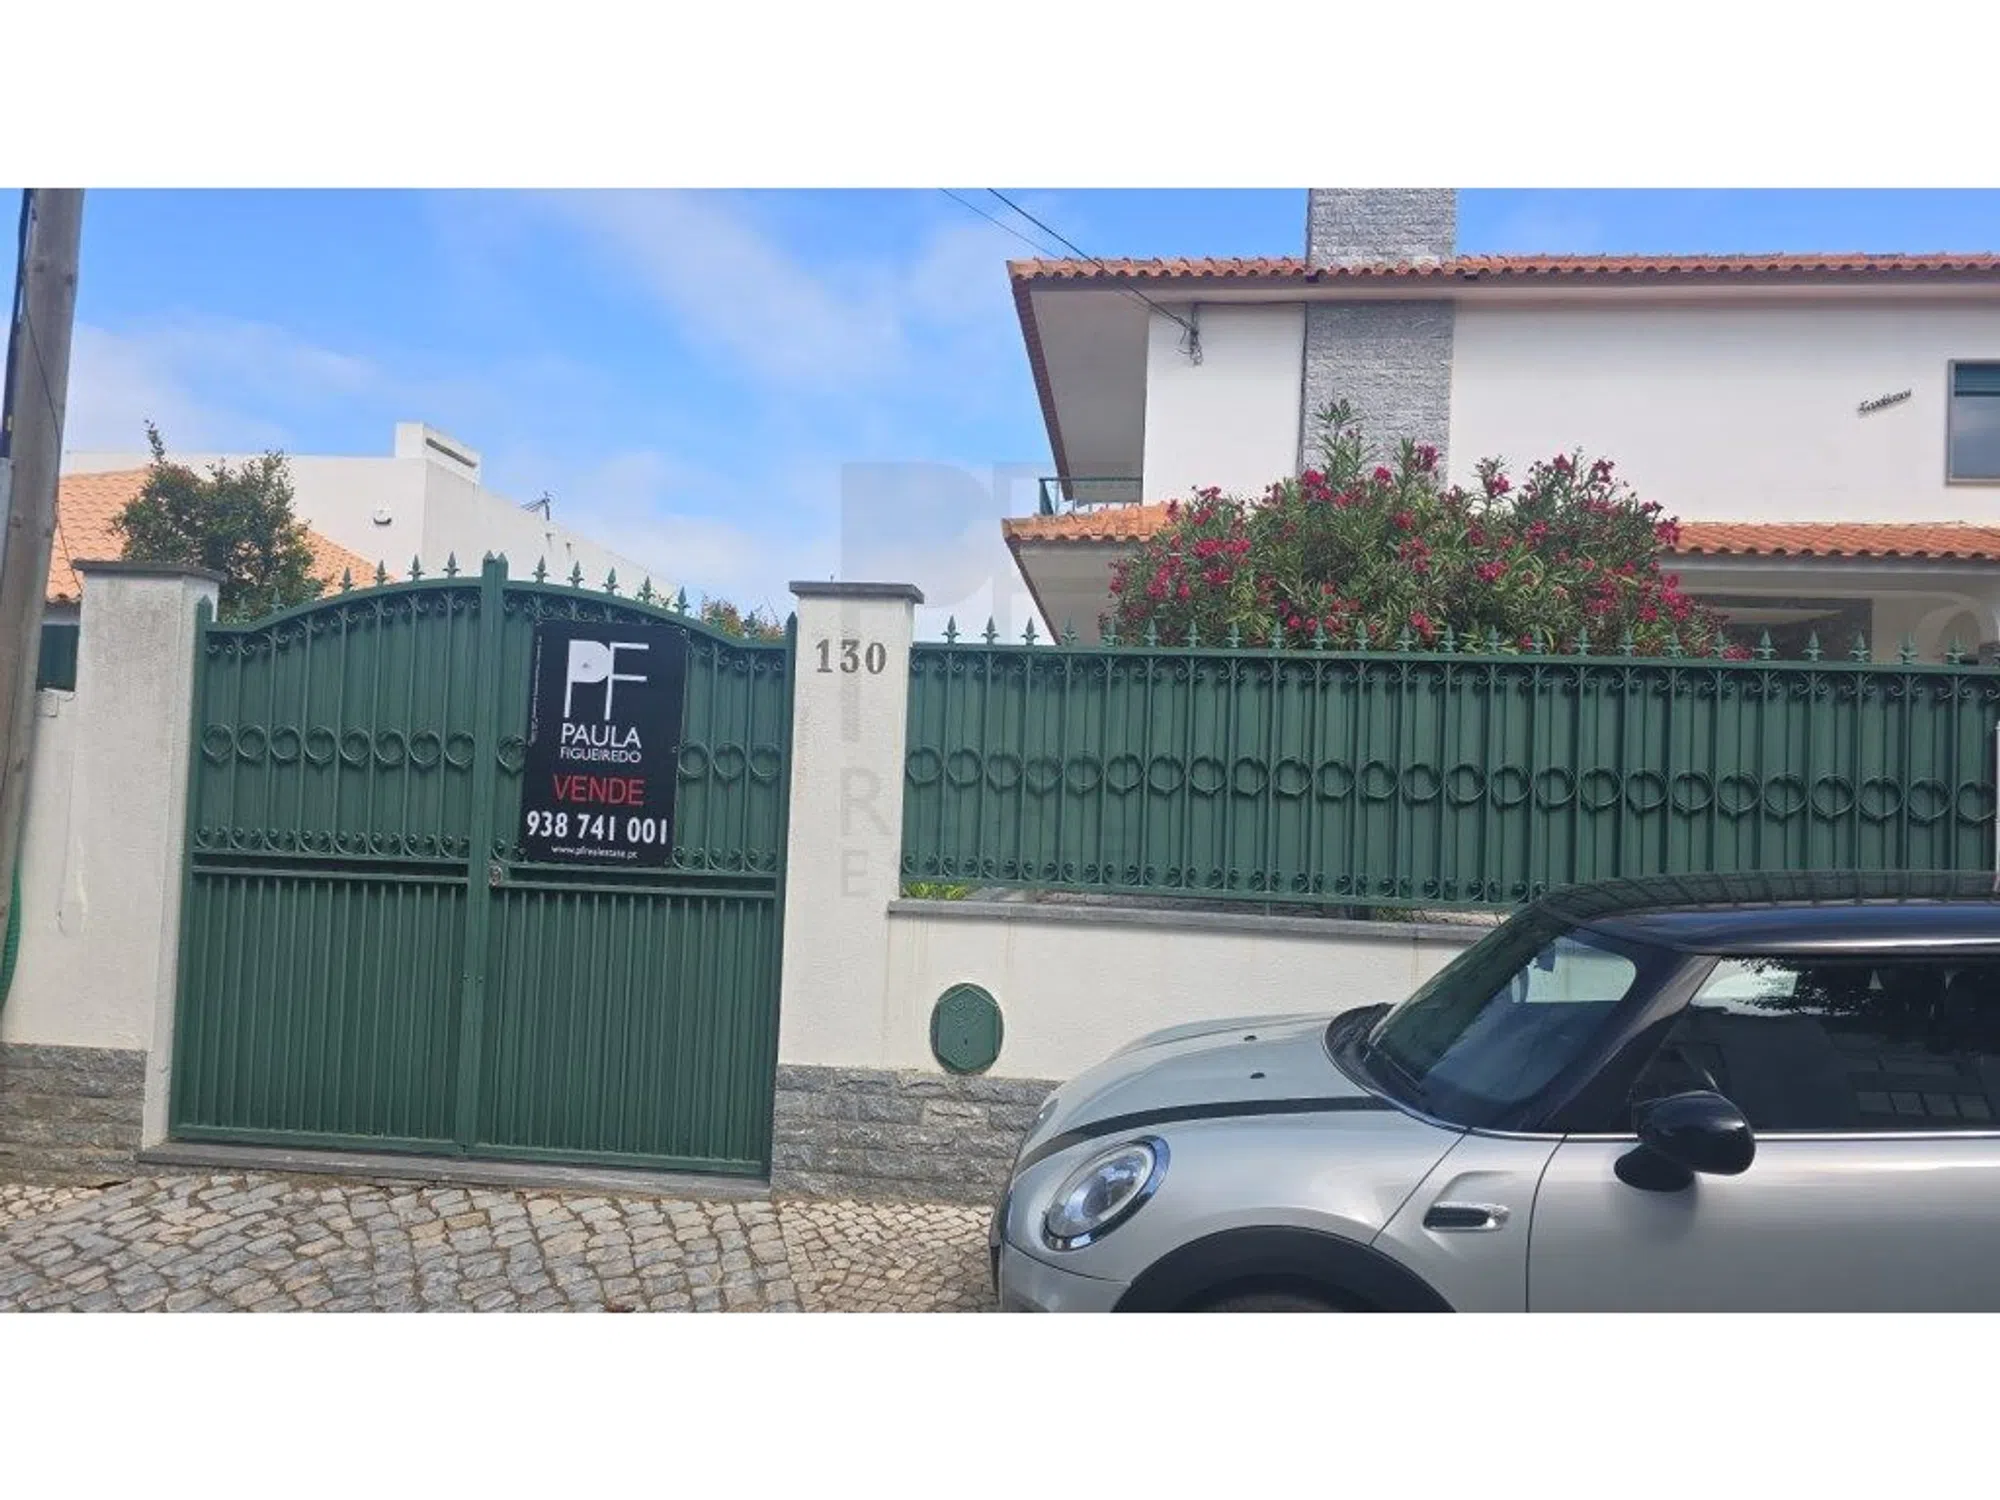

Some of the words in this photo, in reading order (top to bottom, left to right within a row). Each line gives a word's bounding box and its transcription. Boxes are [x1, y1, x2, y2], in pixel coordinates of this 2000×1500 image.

[816, 638, 886, 674] 130
[563, 639, 650, 721] PF
[560, 722, 642, 749] PAULA
[559, 746, 642, 764] FIGUEIREDO
[552, 773, 645, 806] VENDE
[526, 810, 568, 838] 938
[577, 813, 616, 841] 741
[626, 816, 668, 845] 001
